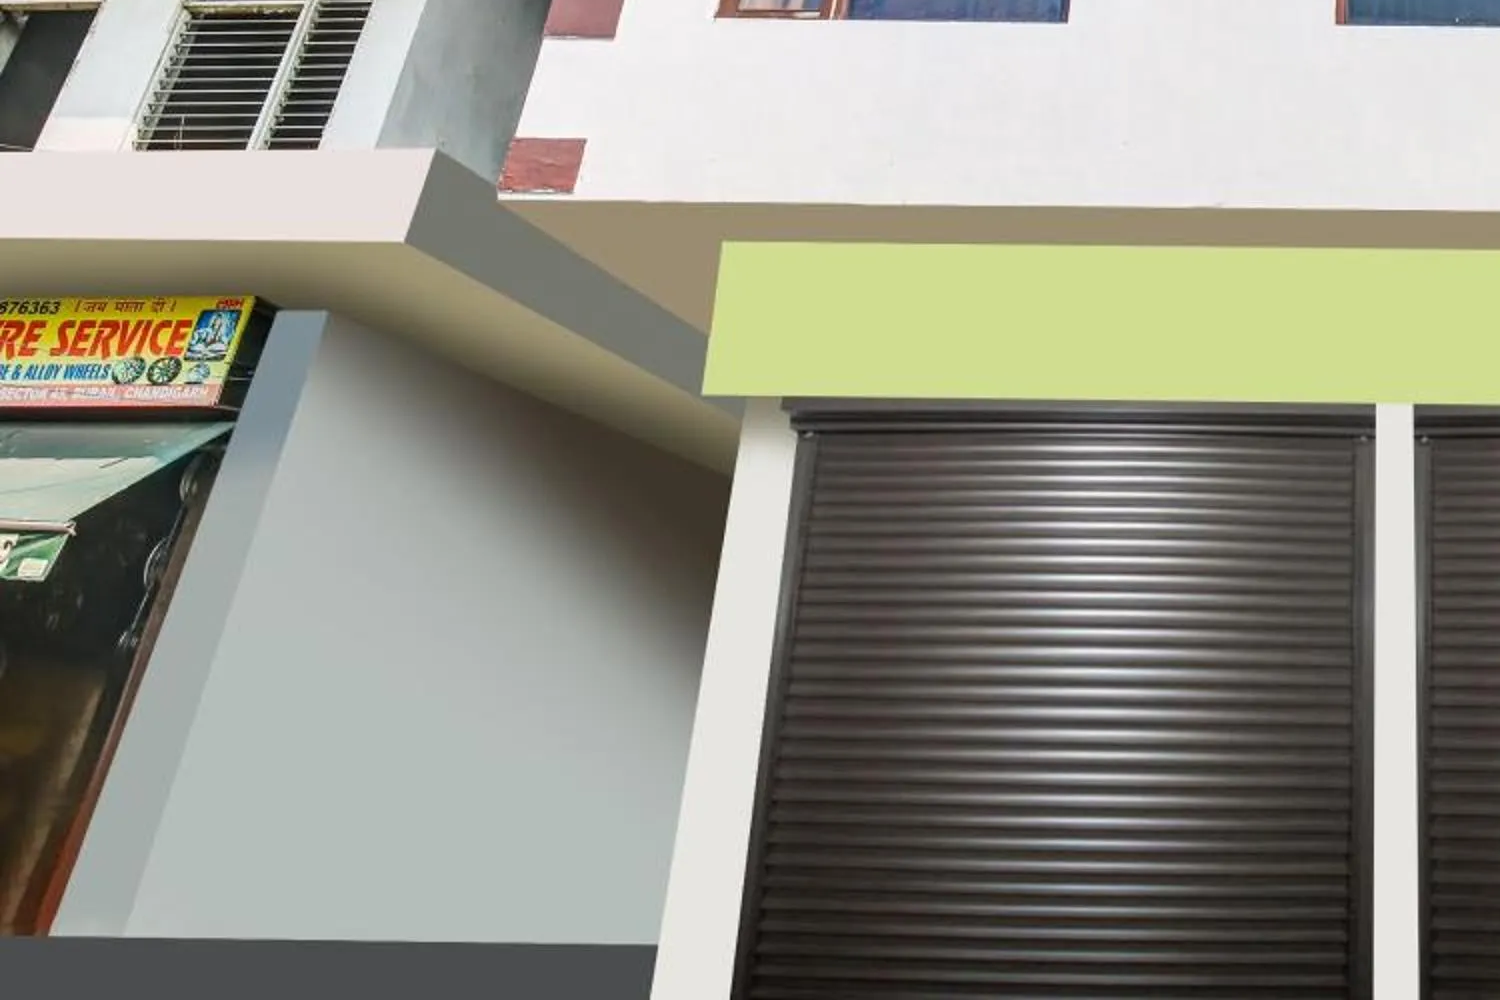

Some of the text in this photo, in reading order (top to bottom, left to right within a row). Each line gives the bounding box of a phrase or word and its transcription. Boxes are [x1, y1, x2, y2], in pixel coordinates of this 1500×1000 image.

[0, 319, 192, 360] RE SERVICE
[24, 364, 62, 380] ALLOY
[64, 363, 112, 380] WHEELS
